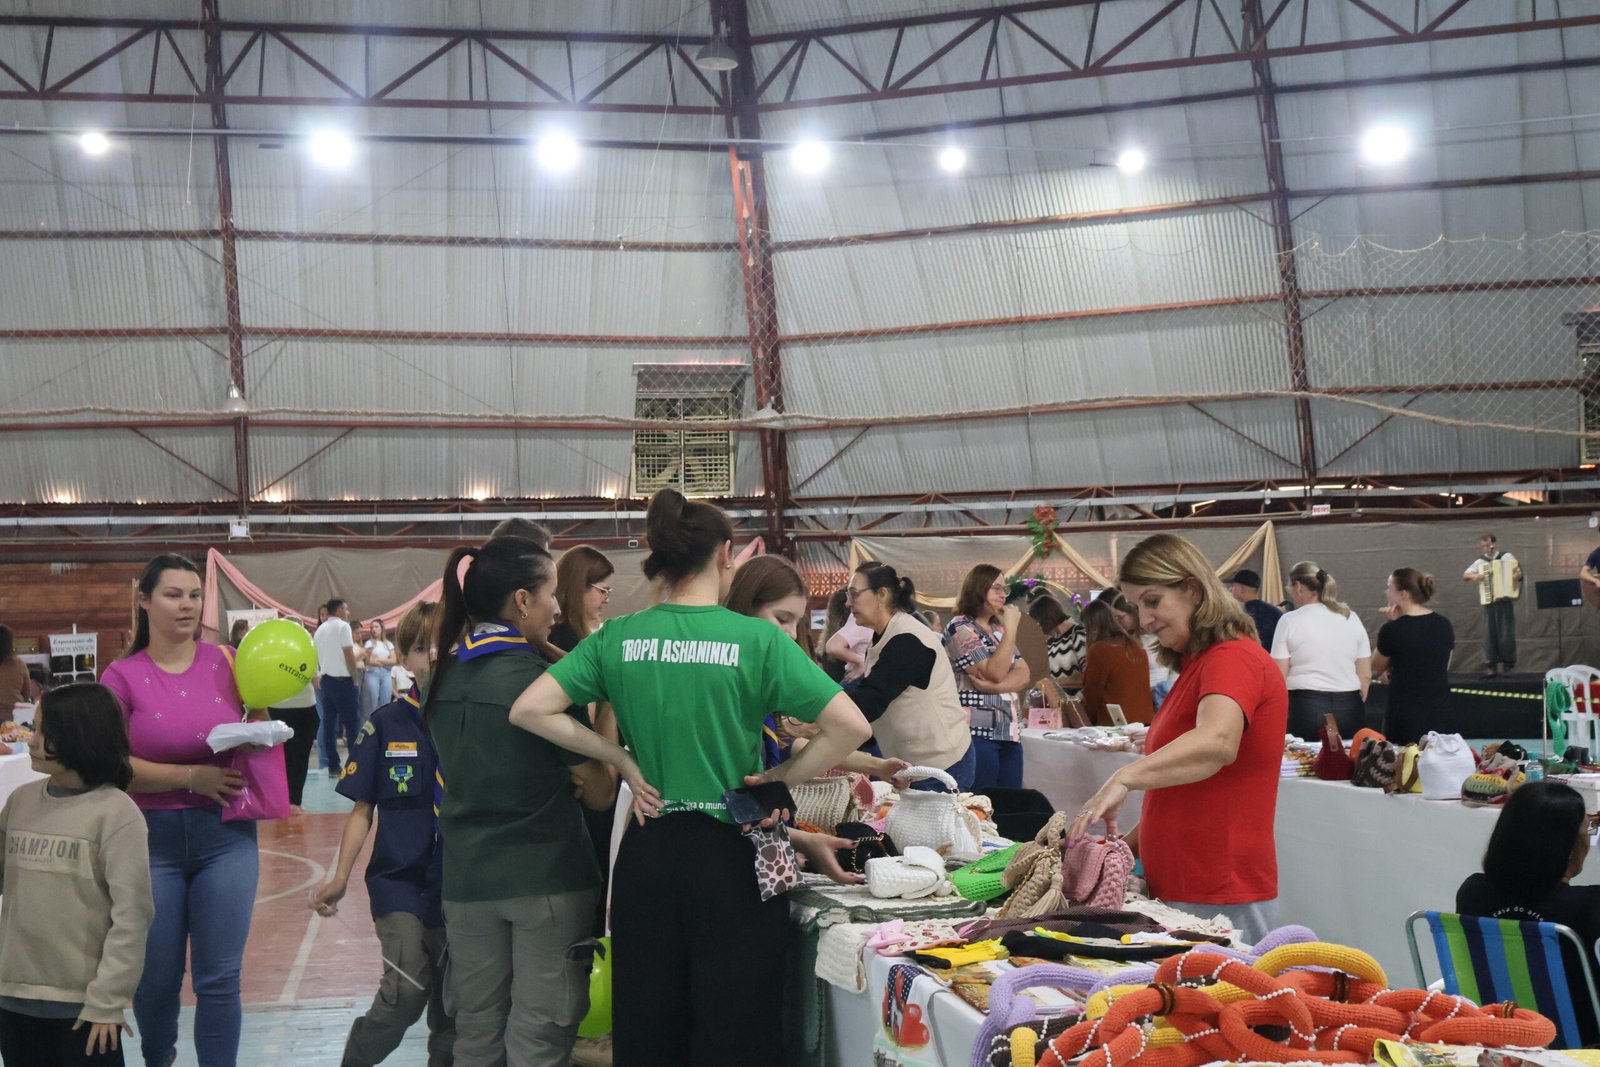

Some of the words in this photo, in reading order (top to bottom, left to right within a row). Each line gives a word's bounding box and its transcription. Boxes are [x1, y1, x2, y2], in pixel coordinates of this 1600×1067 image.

[622, 638, 659, 662] TROPA
[661, 639, 740, 667] ASHANINKA
[8, 836, 80, 860] CHAMPION
